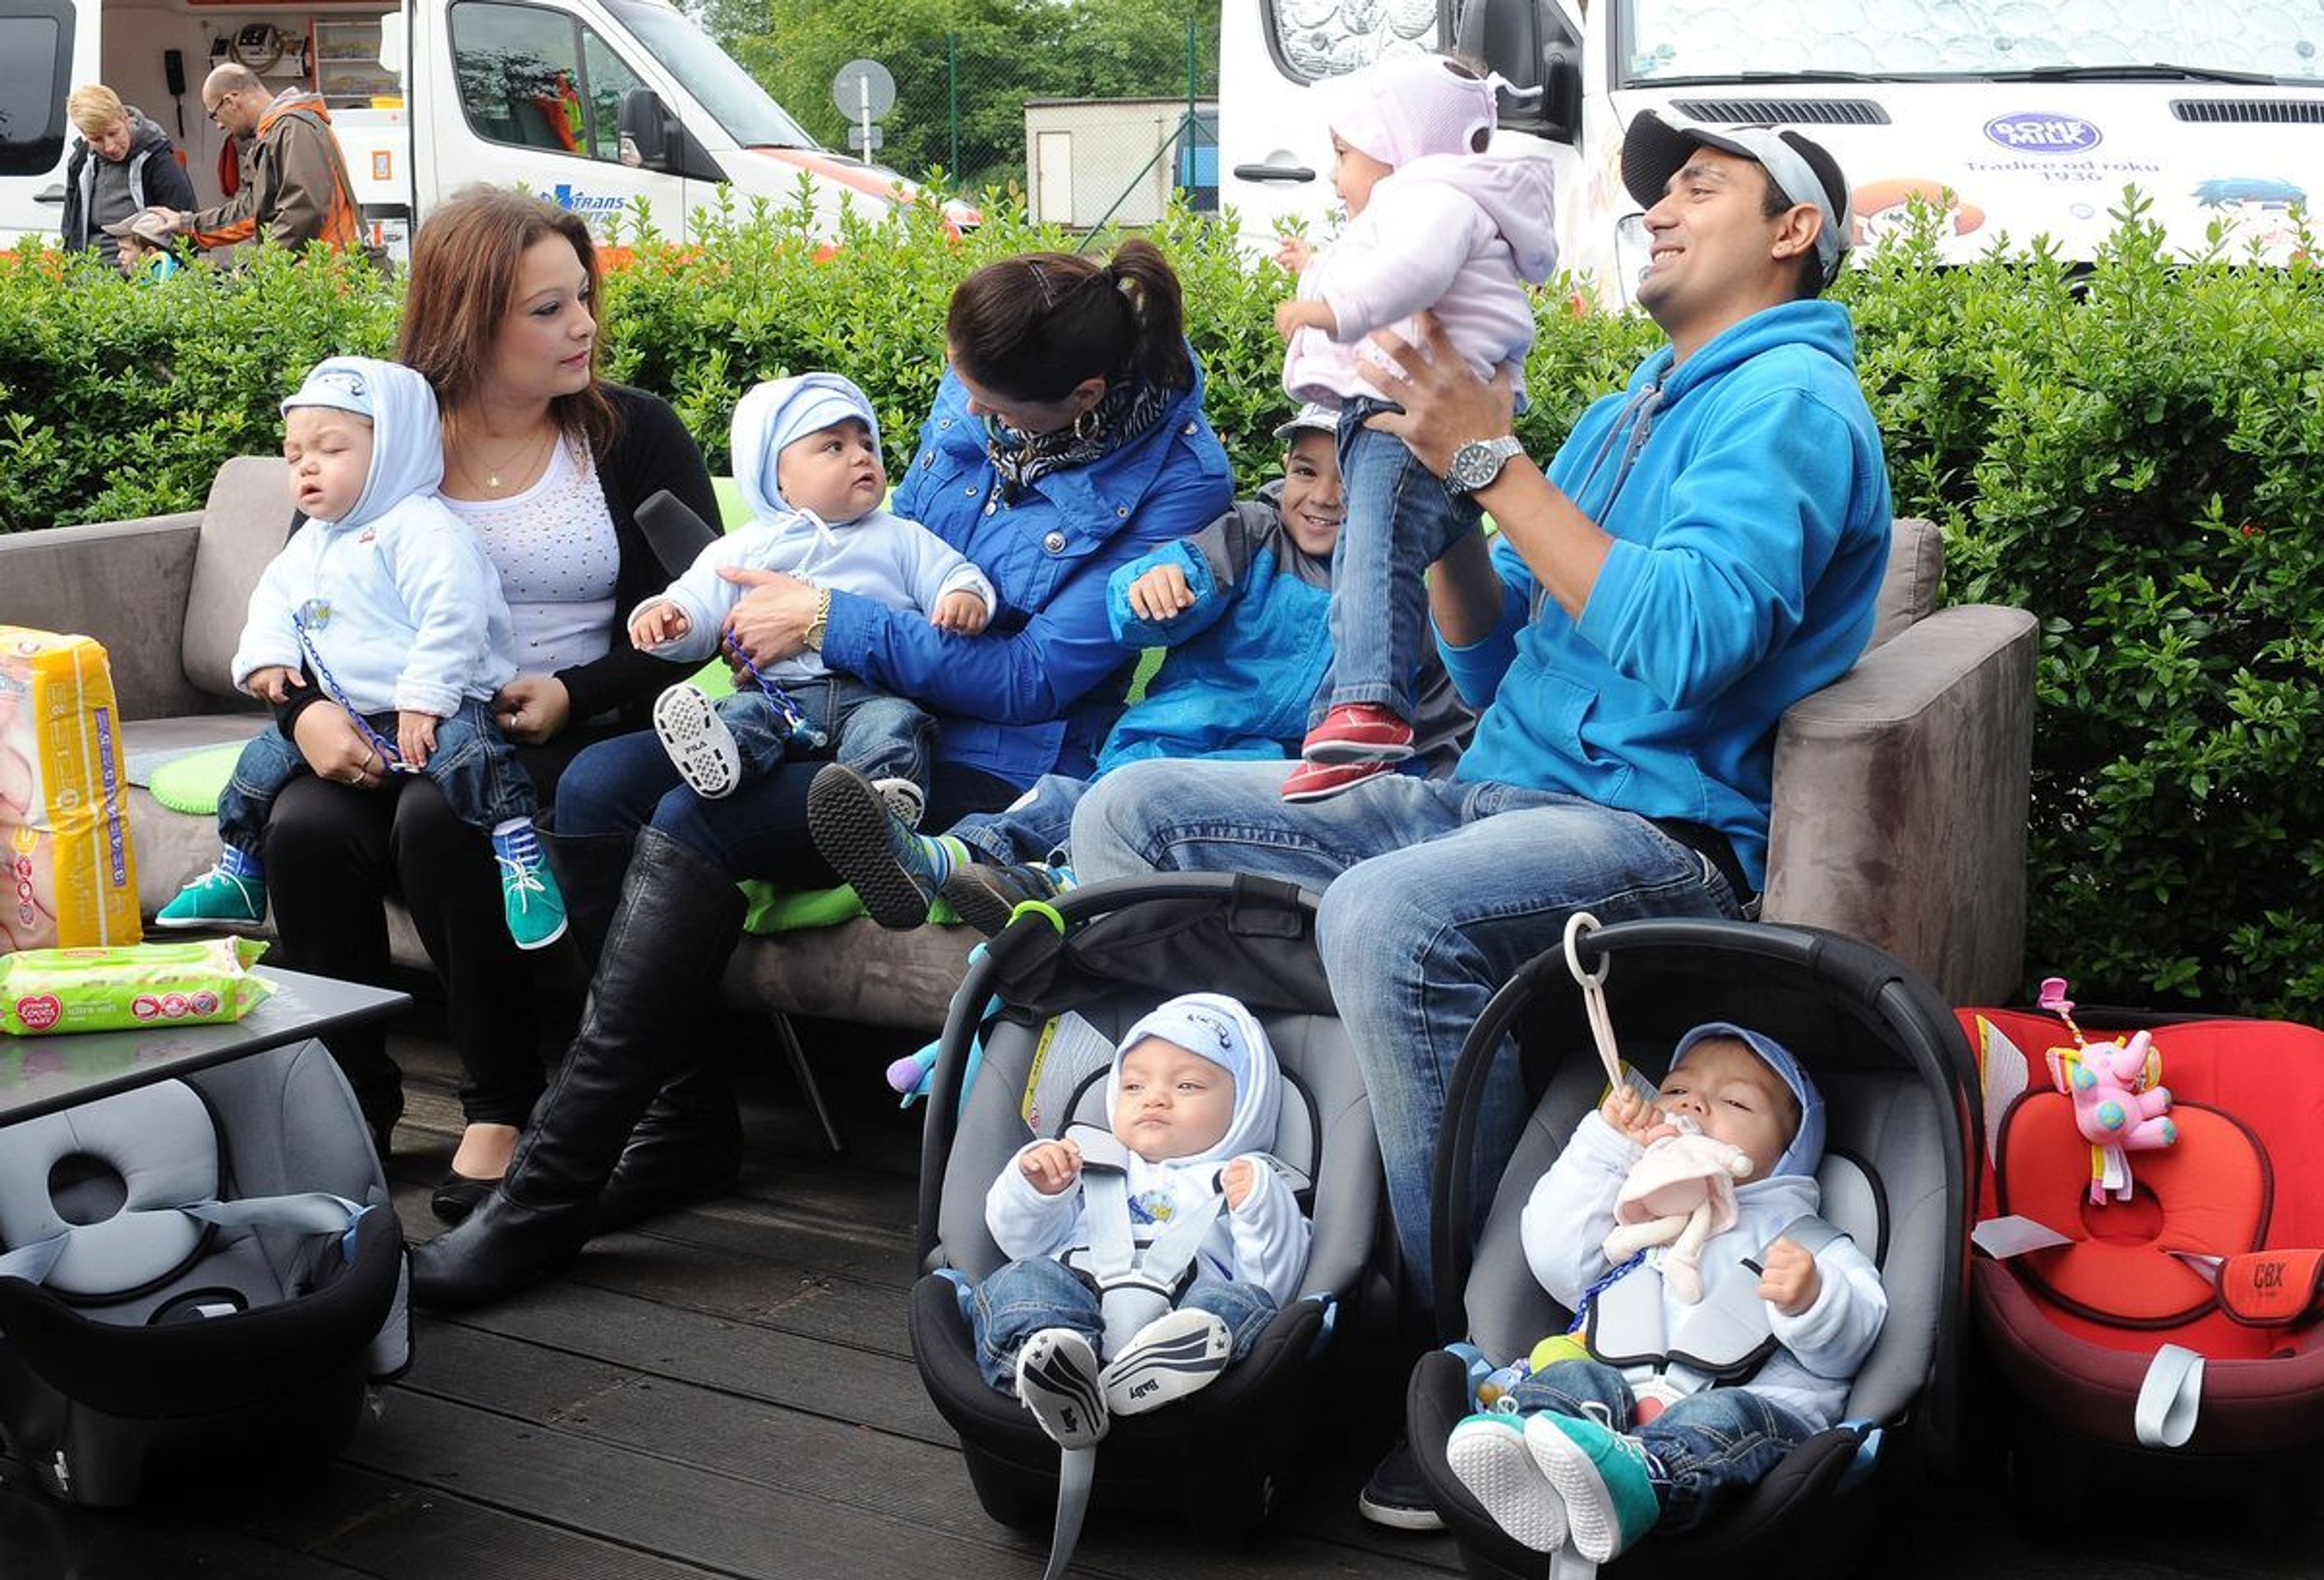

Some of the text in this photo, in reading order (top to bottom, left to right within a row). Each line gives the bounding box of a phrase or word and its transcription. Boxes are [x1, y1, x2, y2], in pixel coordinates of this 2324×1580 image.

[2008, 132, 2085, 144] MILK
[2062, 160, 2094, 170] od
[2103, 160, 2160, 171] roku
